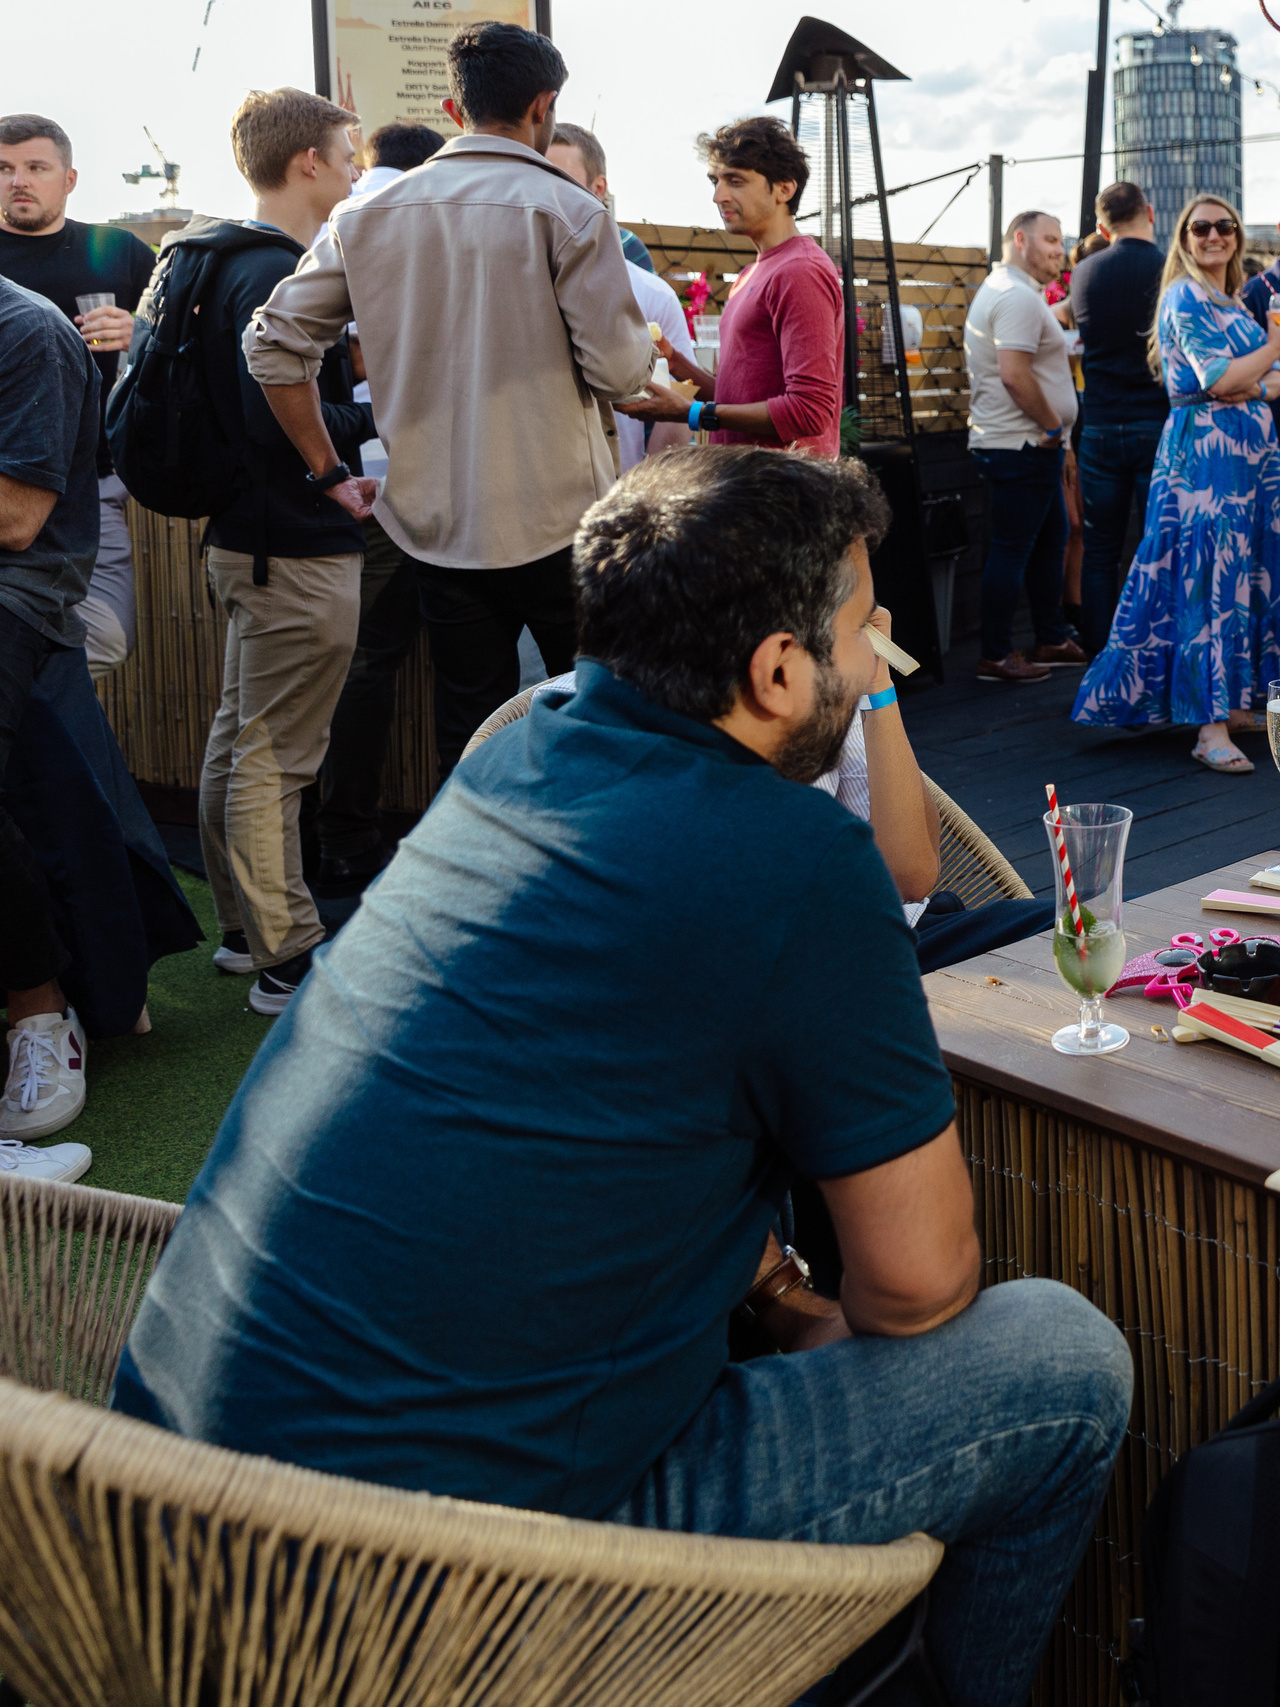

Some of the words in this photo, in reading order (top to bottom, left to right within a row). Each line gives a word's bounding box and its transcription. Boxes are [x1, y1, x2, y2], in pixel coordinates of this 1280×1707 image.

[413, 1, 431, 9] All
[391, 20, 425, 28] Estrella
[388, 35, 422, 43] Estrella
